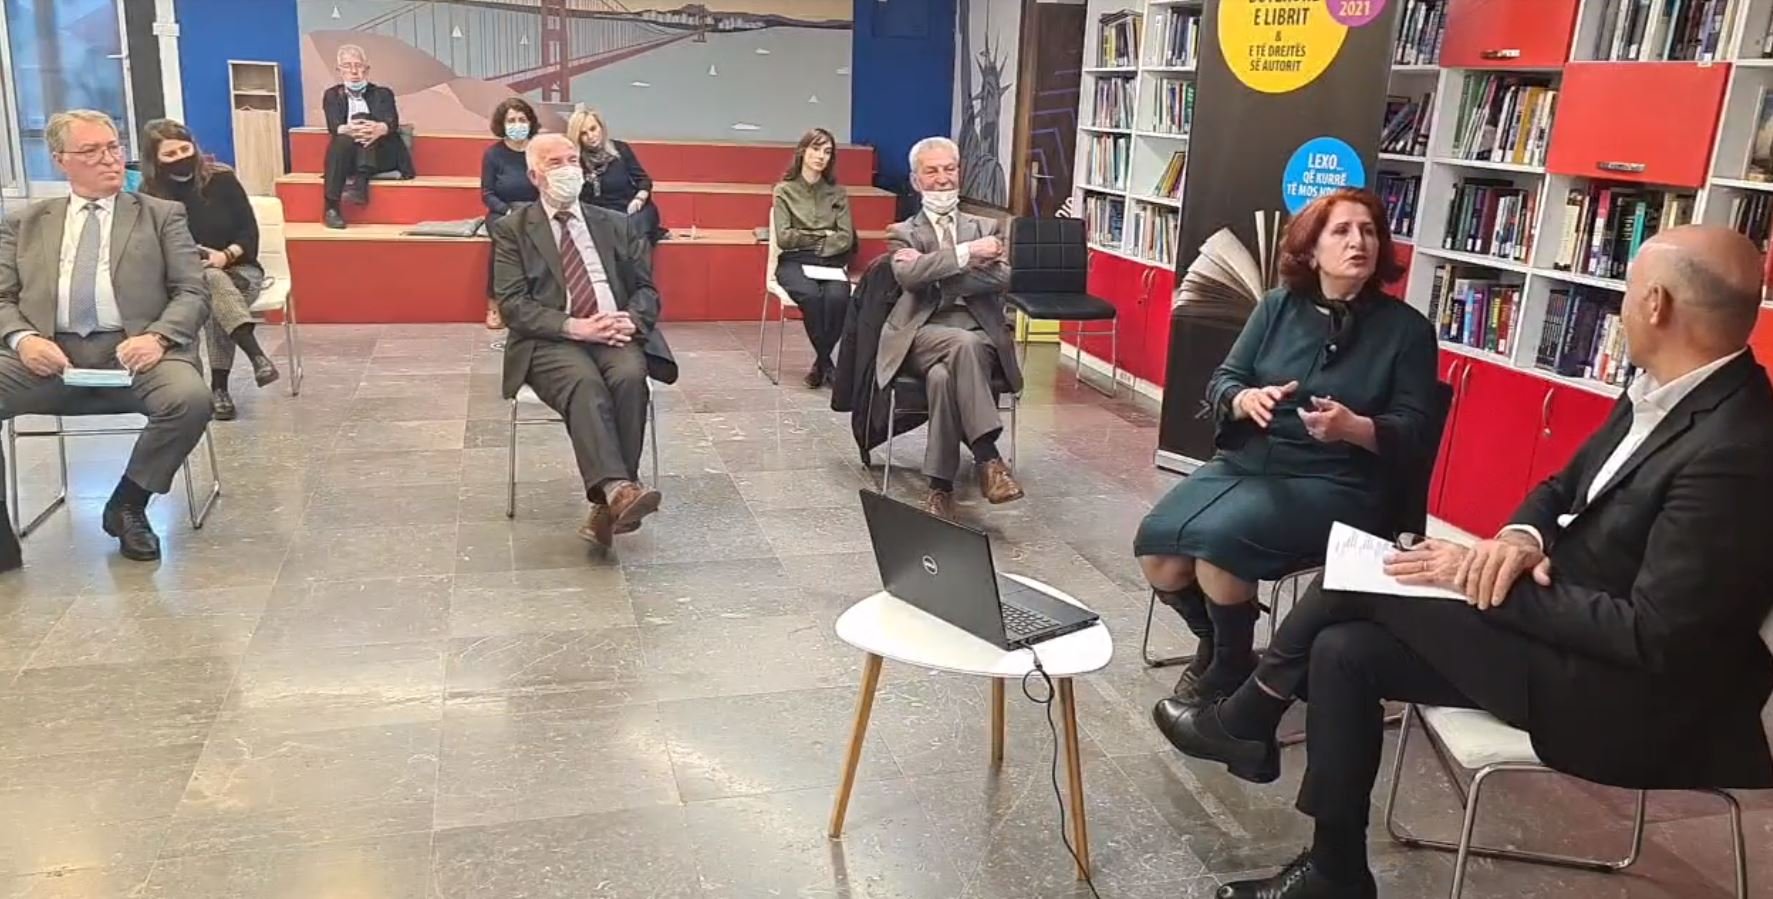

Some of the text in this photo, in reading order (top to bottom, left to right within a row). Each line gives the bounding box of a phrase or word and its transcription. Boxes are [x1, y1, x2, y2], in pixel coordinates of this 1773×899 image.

[1339, 0, 1370, 16] 2021
[1254, 8, 1310, 26] E LIBRIT
[1275, 31, 1282, 42] &
[1249, 45, 1255, 57] E
[1249, 58, 1302, 72] SË AUTORIT
[1298, 184, 1318, 197] MOS
